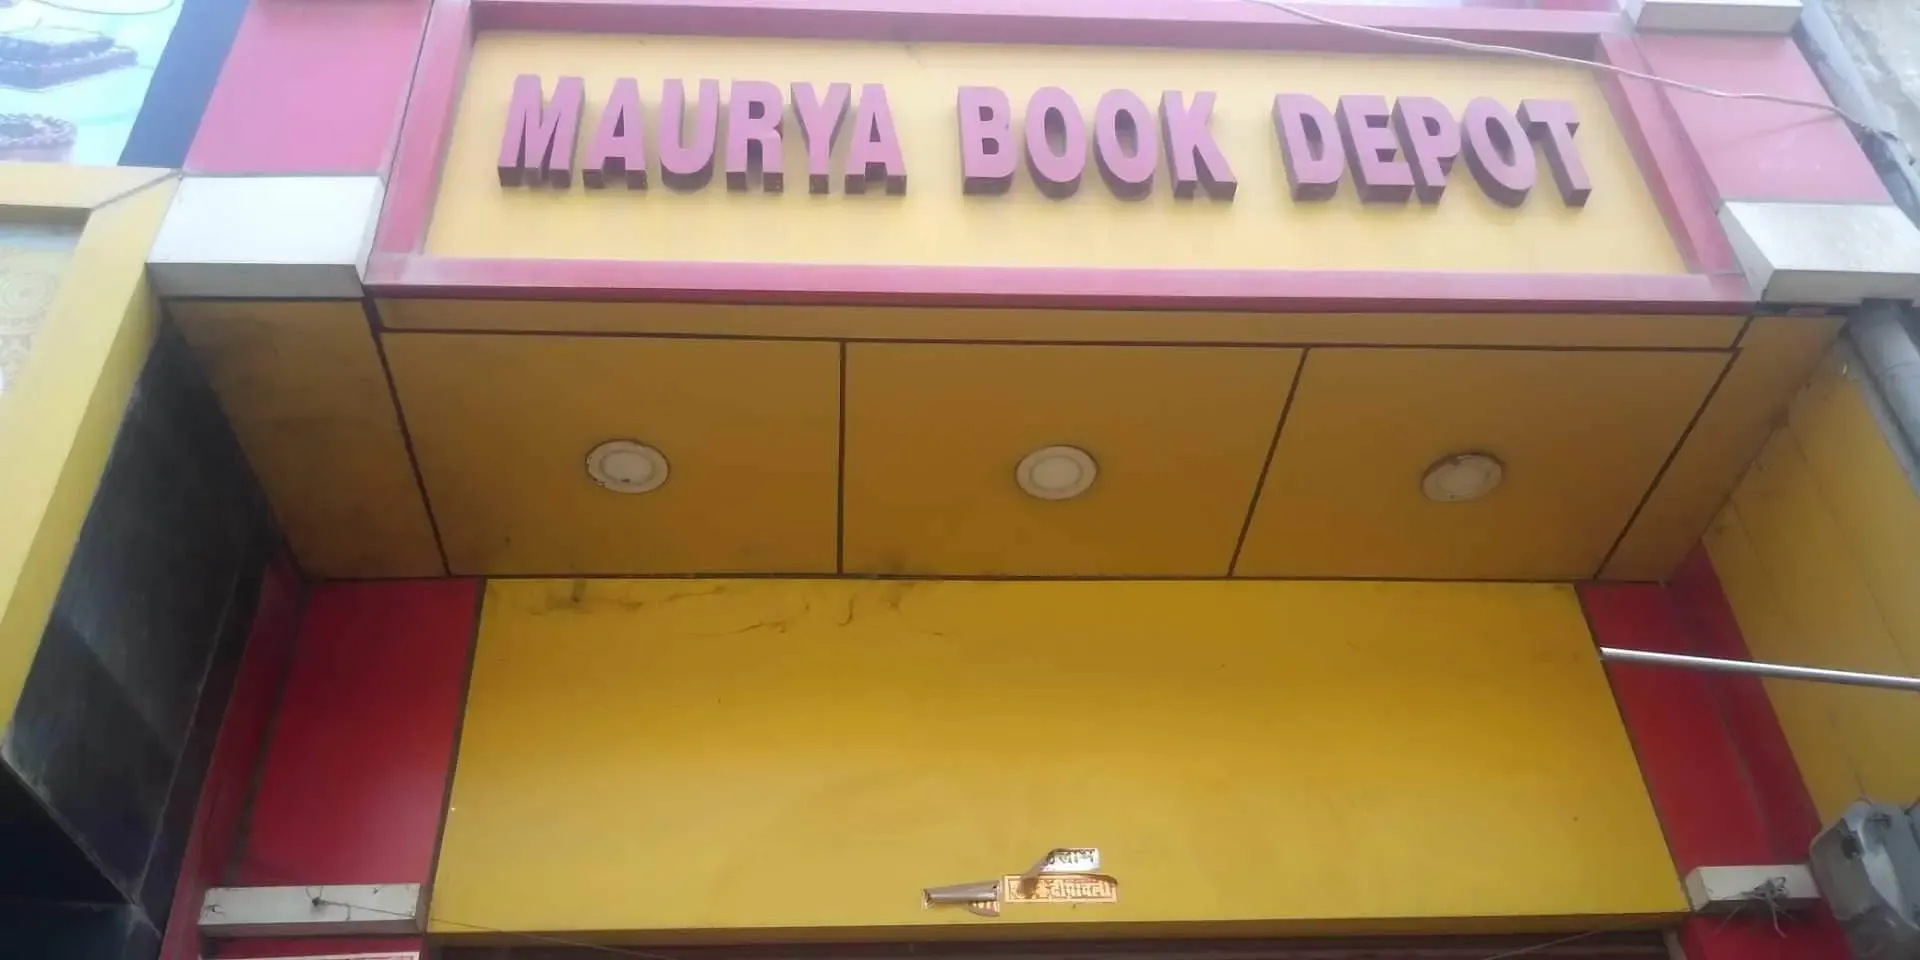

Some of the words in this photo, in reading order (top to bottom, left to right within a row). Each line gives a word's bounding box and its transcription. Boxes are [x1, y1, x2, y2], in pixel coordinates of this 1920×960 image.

[498, 74, 907, 195] MAURYA
[957, 86, 1237, 200] BOOK
[1272, 93, 1592, 207] DEPOT
